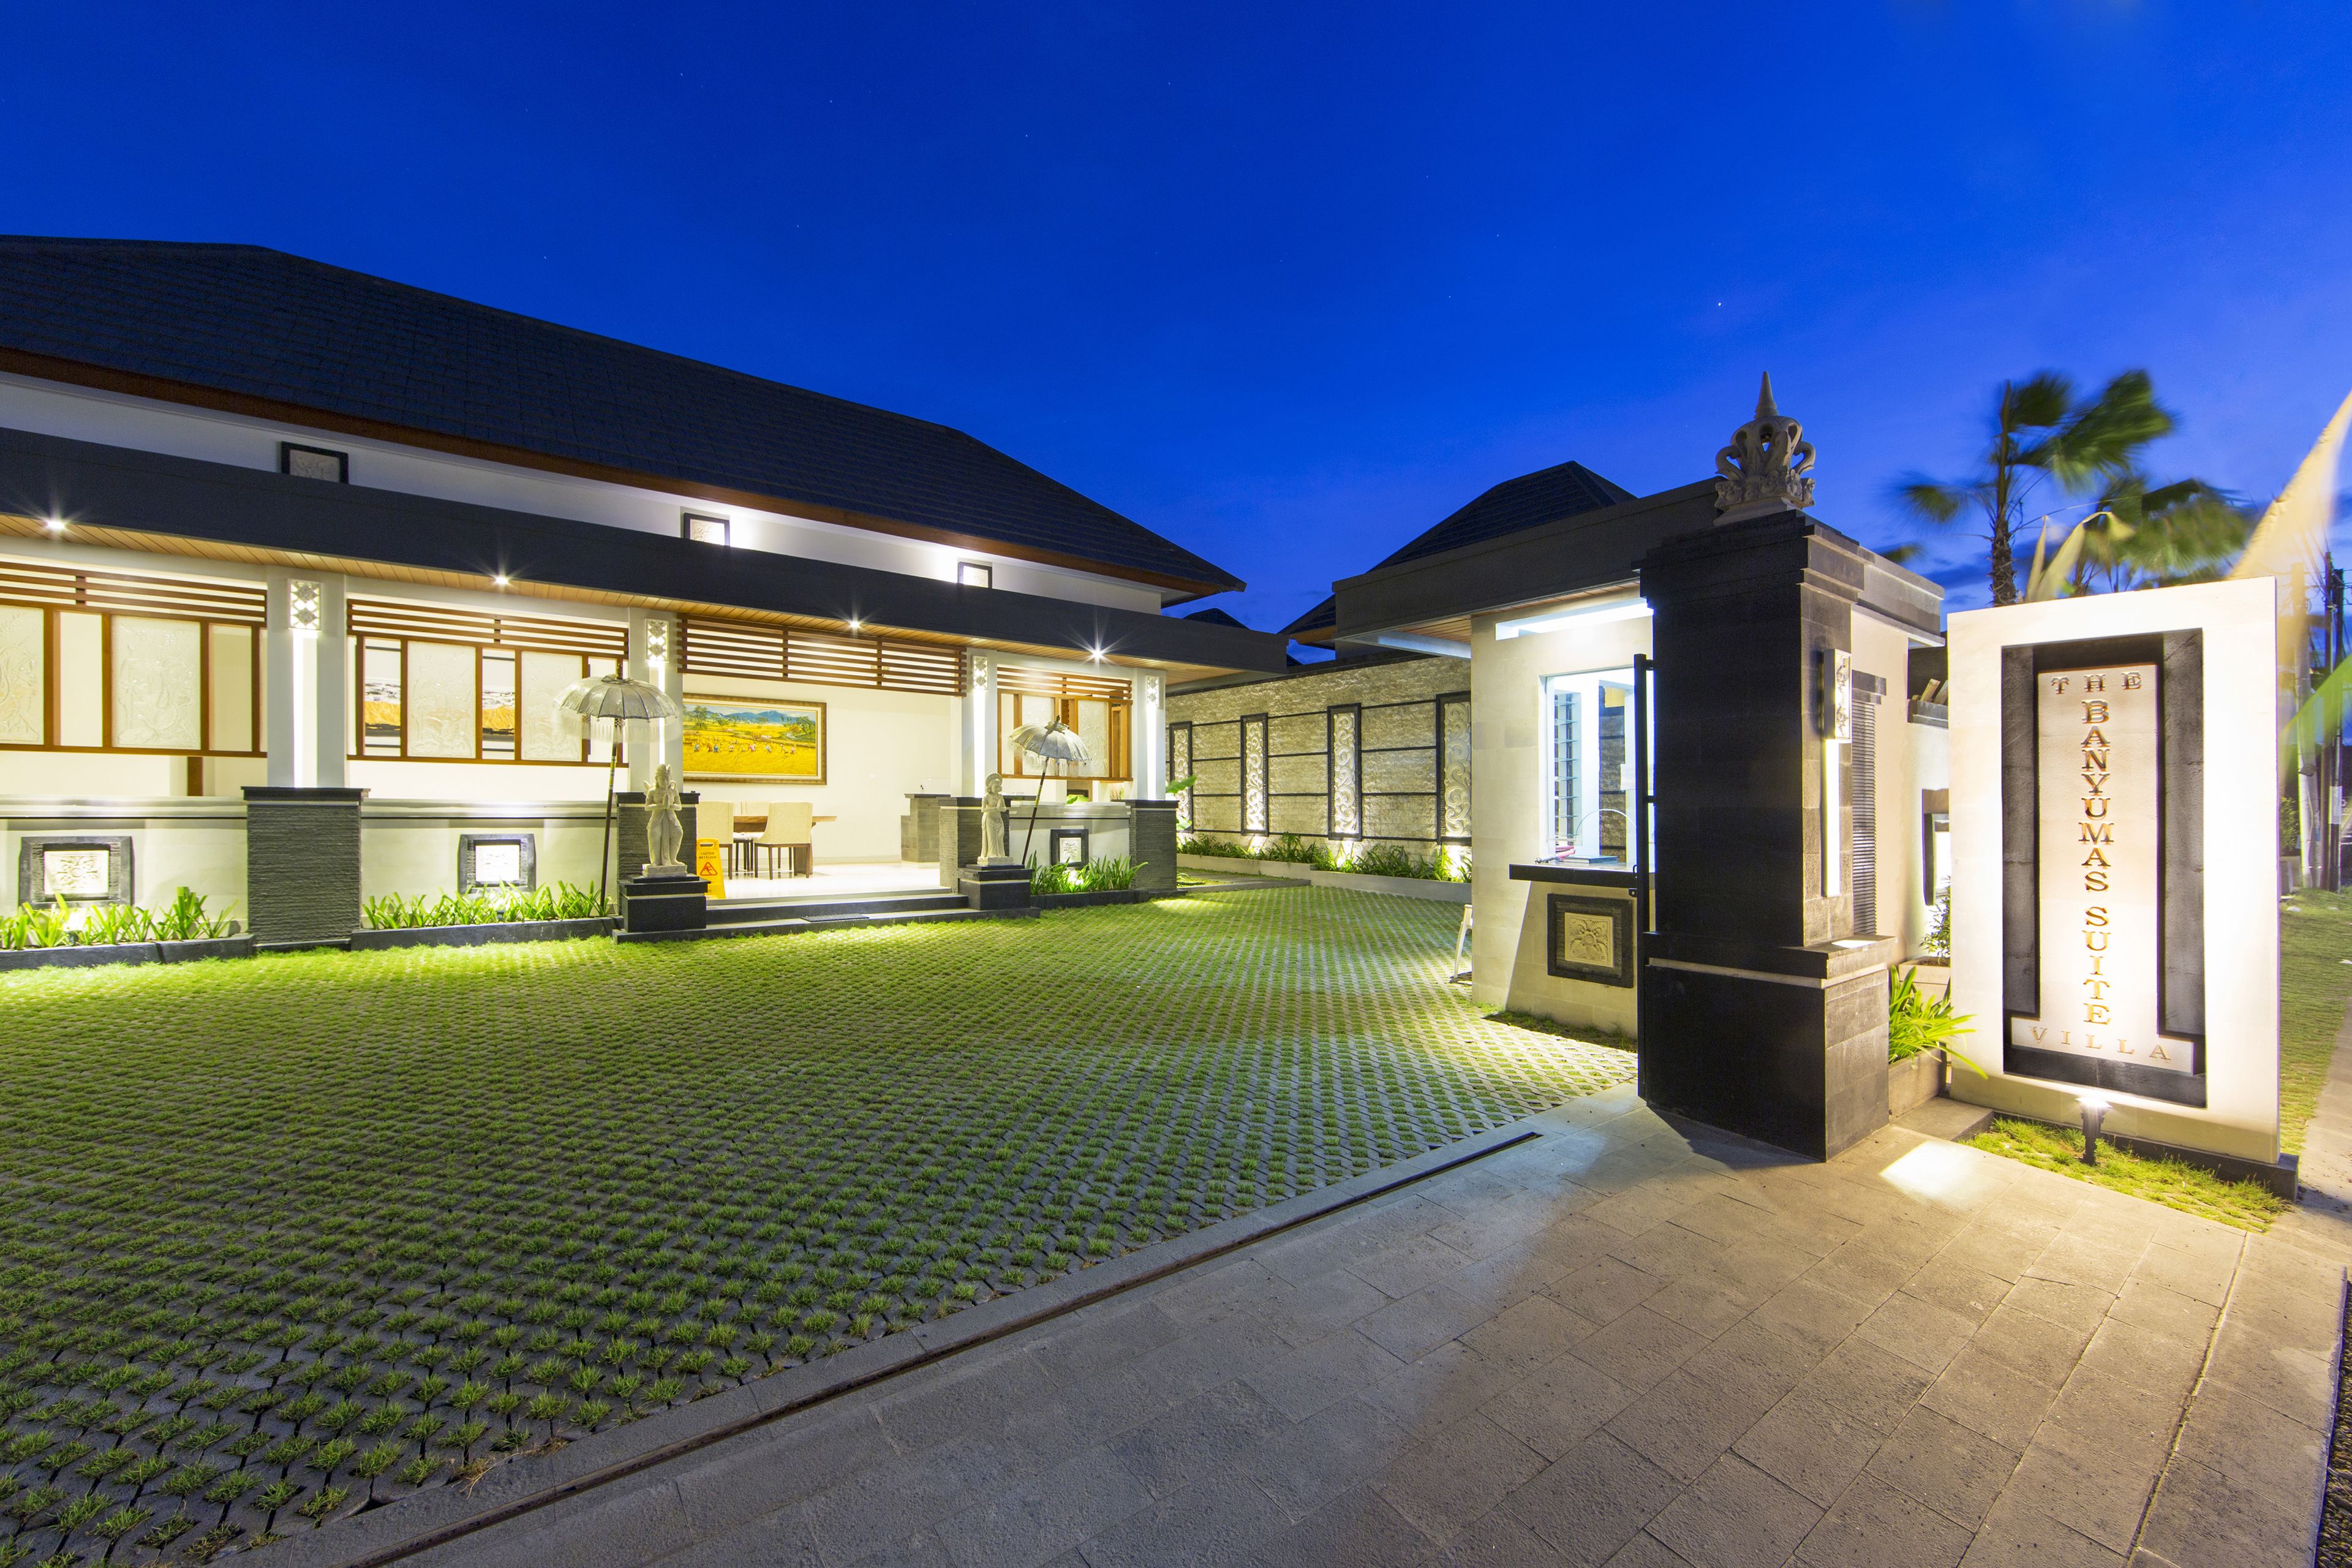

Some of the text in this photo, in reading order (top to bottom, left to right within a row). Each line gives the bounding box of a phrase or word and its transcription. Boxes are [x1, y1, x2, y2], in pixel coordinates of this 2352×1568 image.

[2051, 671, 2141, 695] THE
[2078, 699, 2114, 1025] BANYUMAS SUITE
[2029, 1026, 2171, 1061] VILLA
